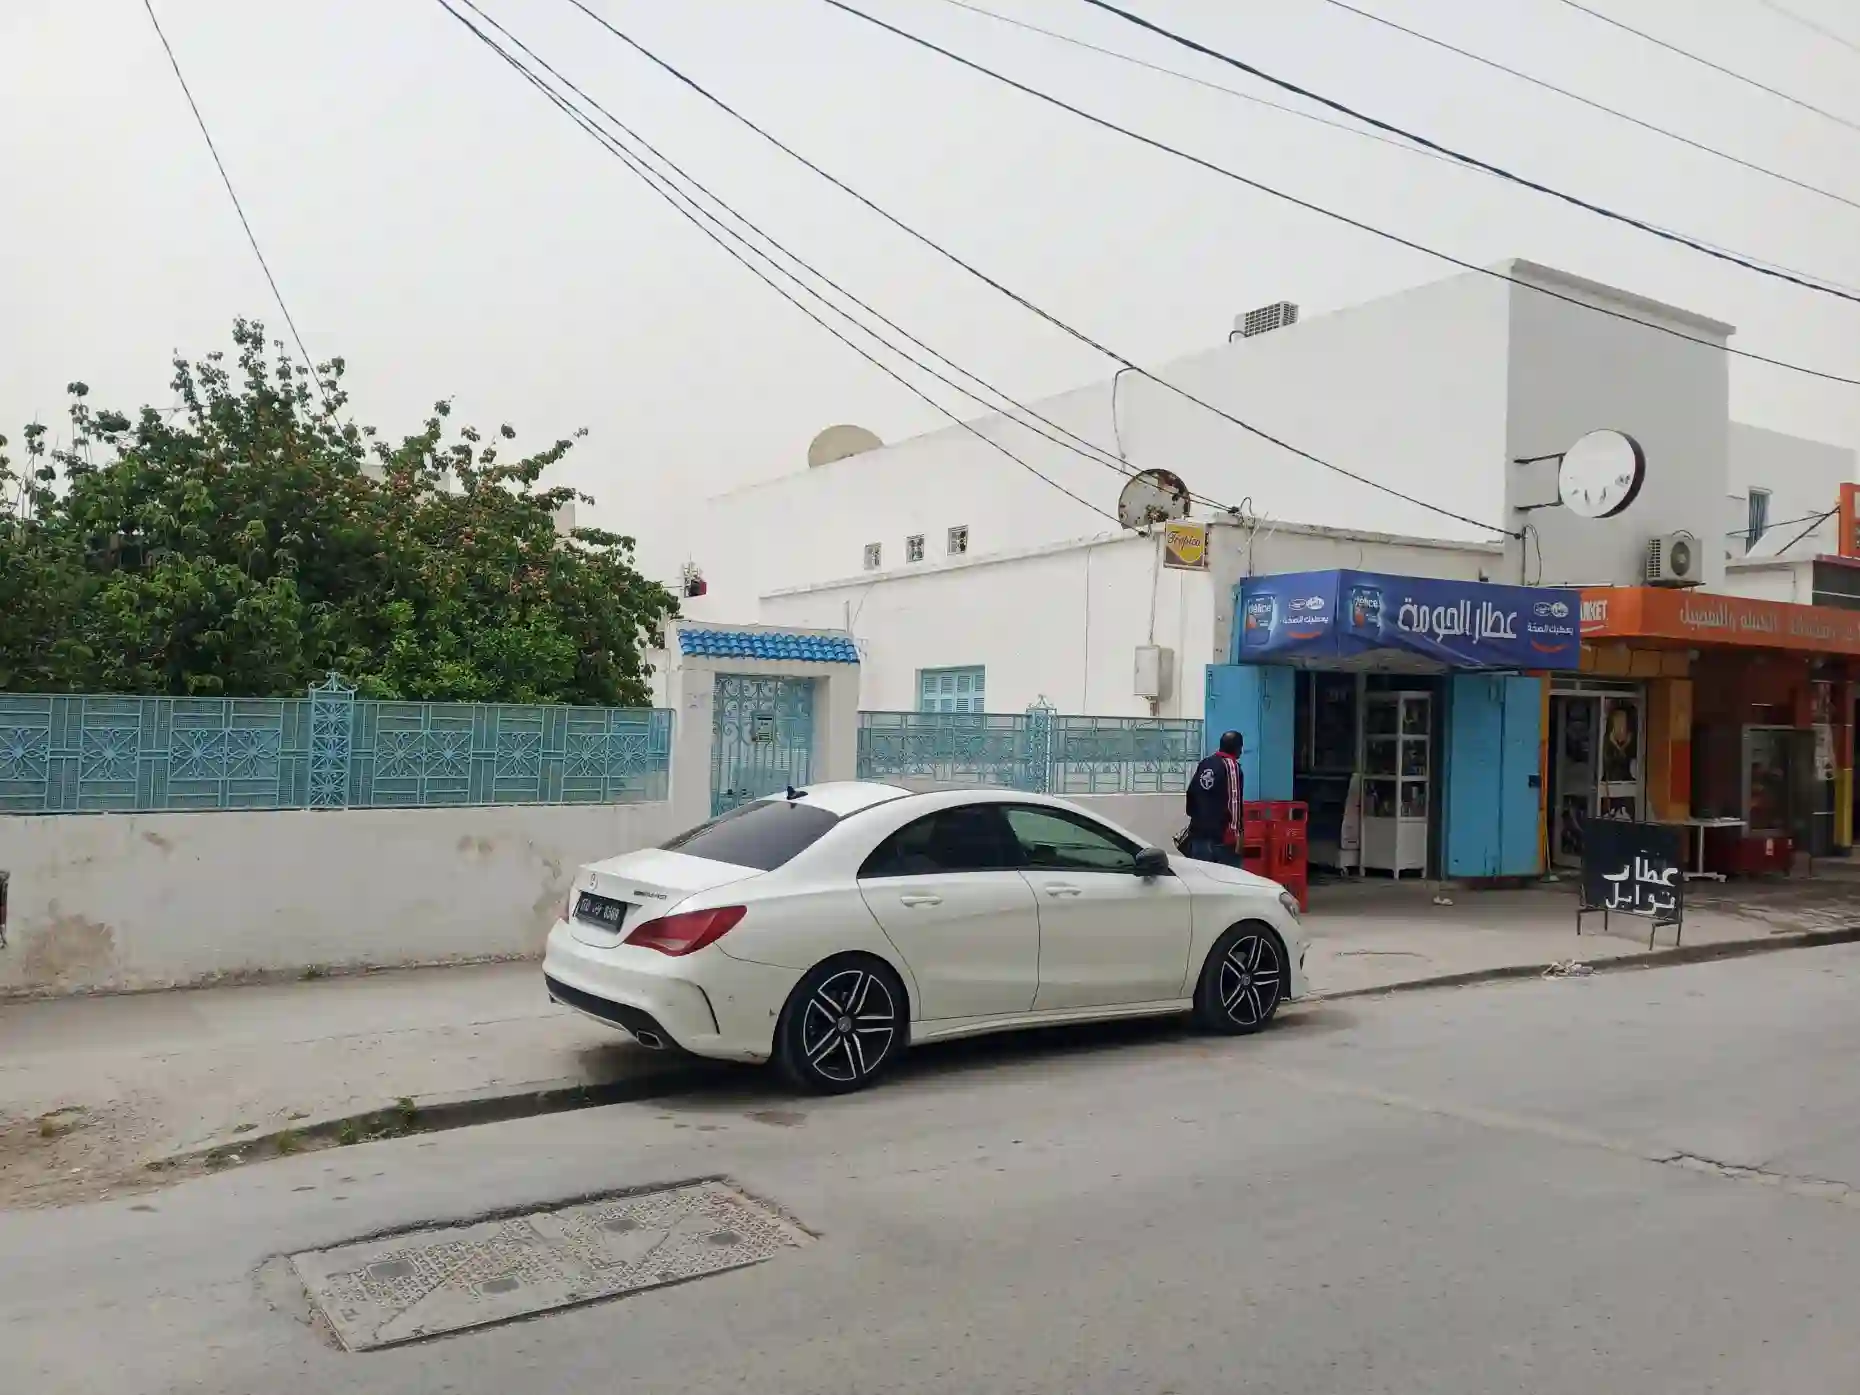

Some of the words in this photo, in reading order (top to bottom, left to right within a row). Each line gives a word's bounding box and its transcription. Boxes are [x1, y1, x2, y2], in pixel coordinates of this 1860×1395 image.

[1398, 597, 1471, 643] الحومة
[1473, 601, 1517, 644] عطار
[1605, 882, 1676, 915] توابل
